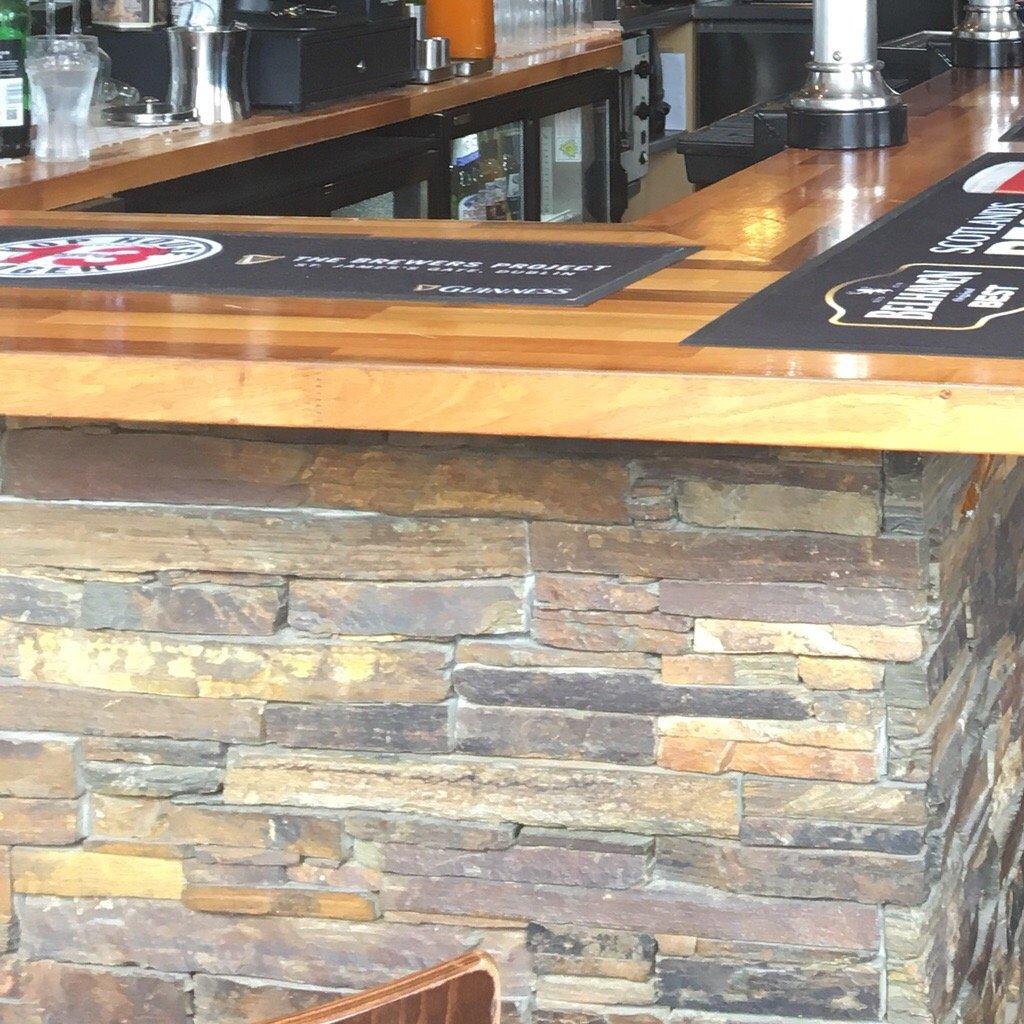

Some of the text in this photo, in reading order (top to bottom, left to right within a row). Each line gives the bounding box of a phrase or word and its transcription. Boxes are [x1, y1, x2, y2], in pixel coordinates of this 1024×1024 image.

[350, 257, 484, 268] BREWERS
[490, 262, 612, 272] PROJECT
[437, 284, 573, 296] GUINNESS
[863, 269, 983, 321] BELHAVEN
[966, 284, 1020, 309] BEST
